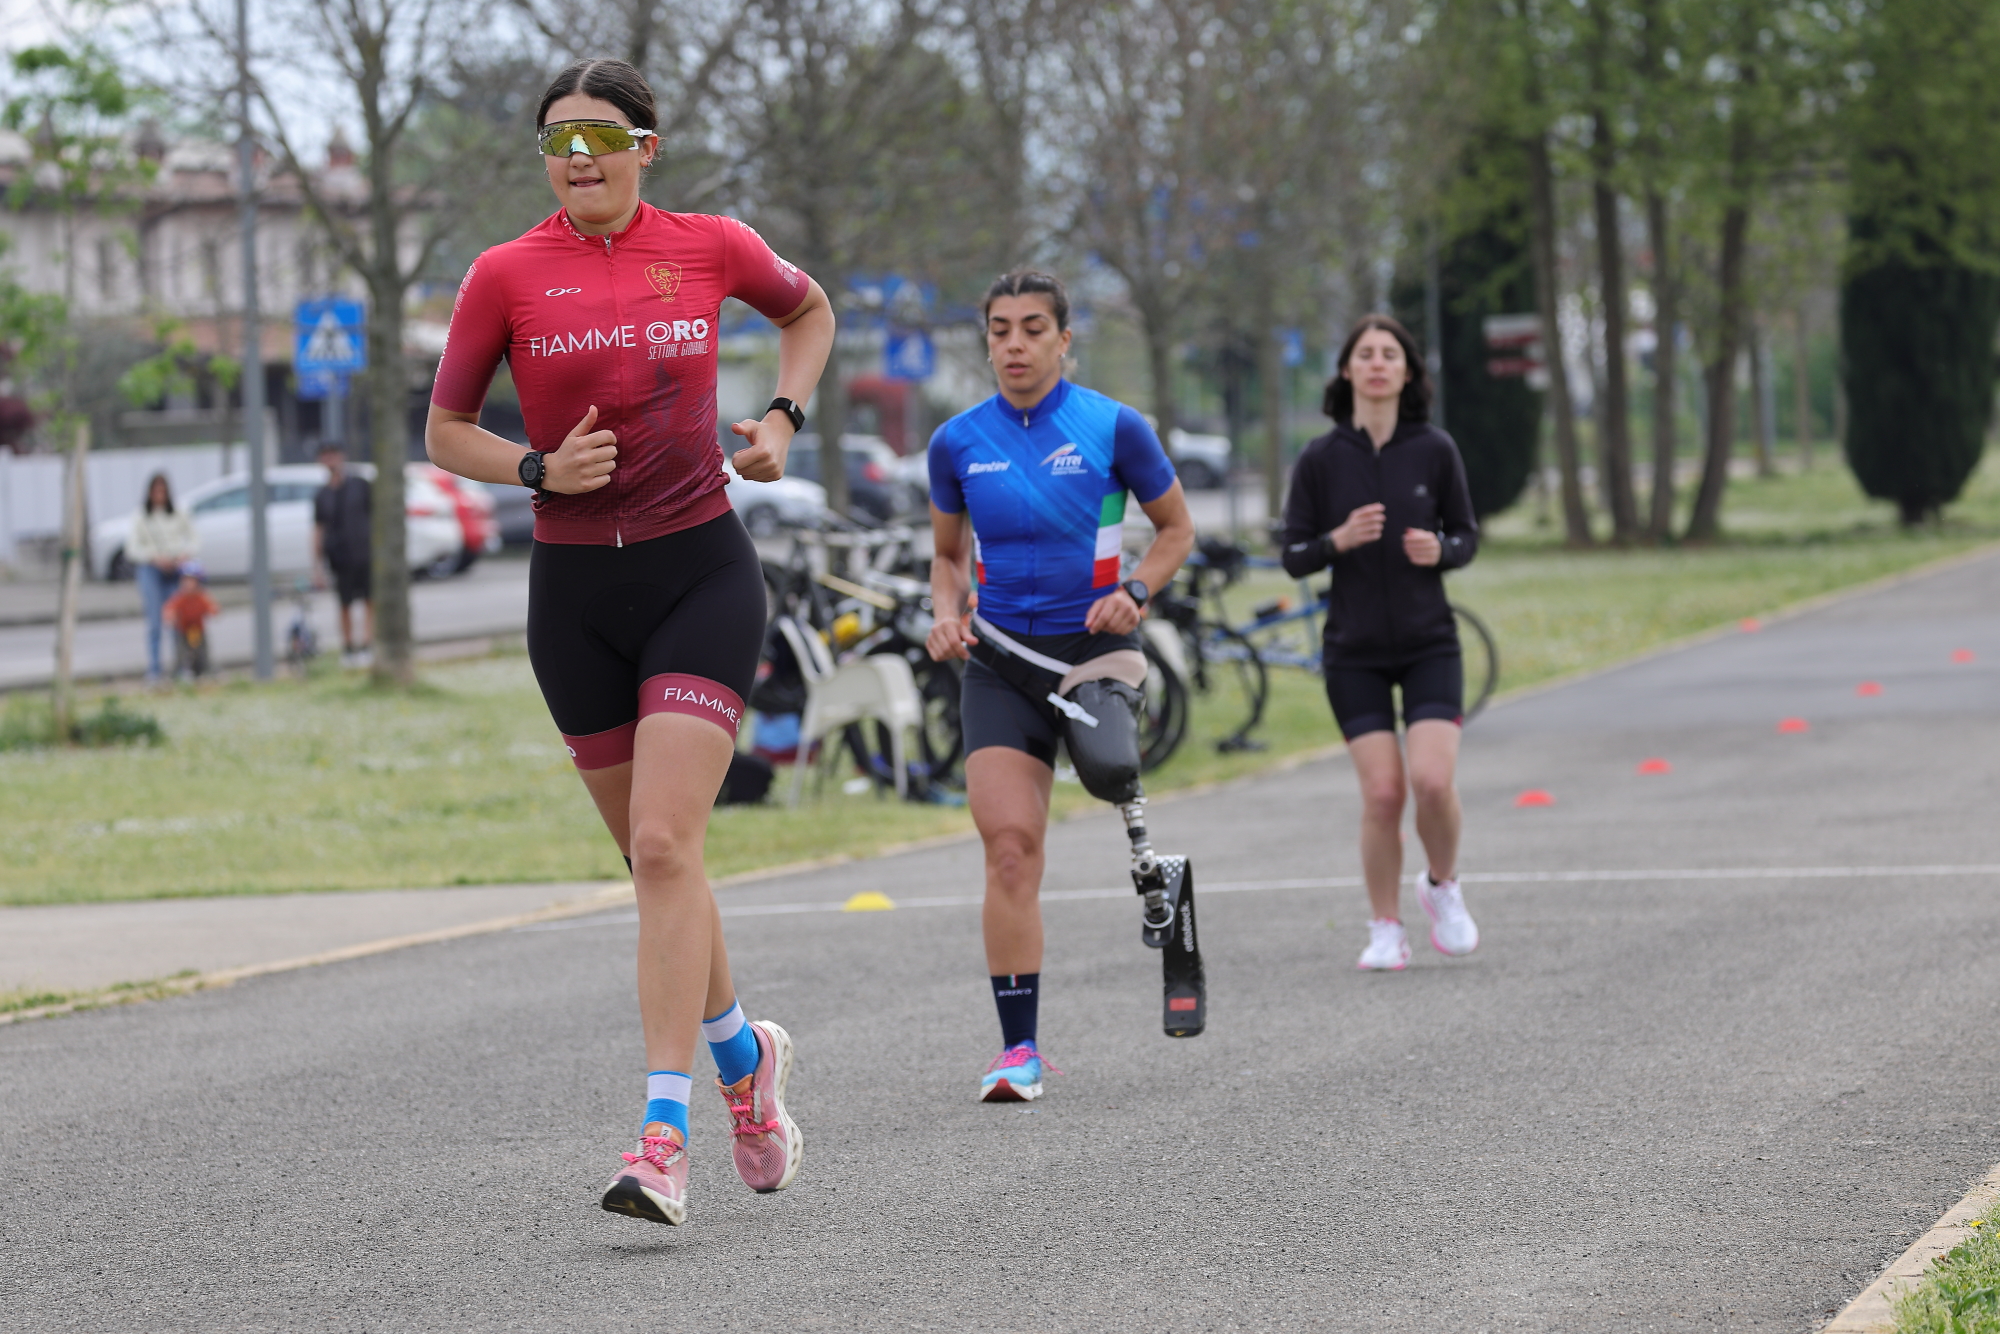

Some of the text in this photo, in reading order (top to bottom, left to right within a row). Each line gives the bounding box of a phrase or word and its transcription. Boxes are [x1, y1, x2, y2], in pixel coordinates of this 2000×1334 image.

[529, 318, 709, 357] FIAMME ORO
[647, 340, 709, 361] SETTORE GIOVANILE
[663, 688, 737, 723] FIAMME
